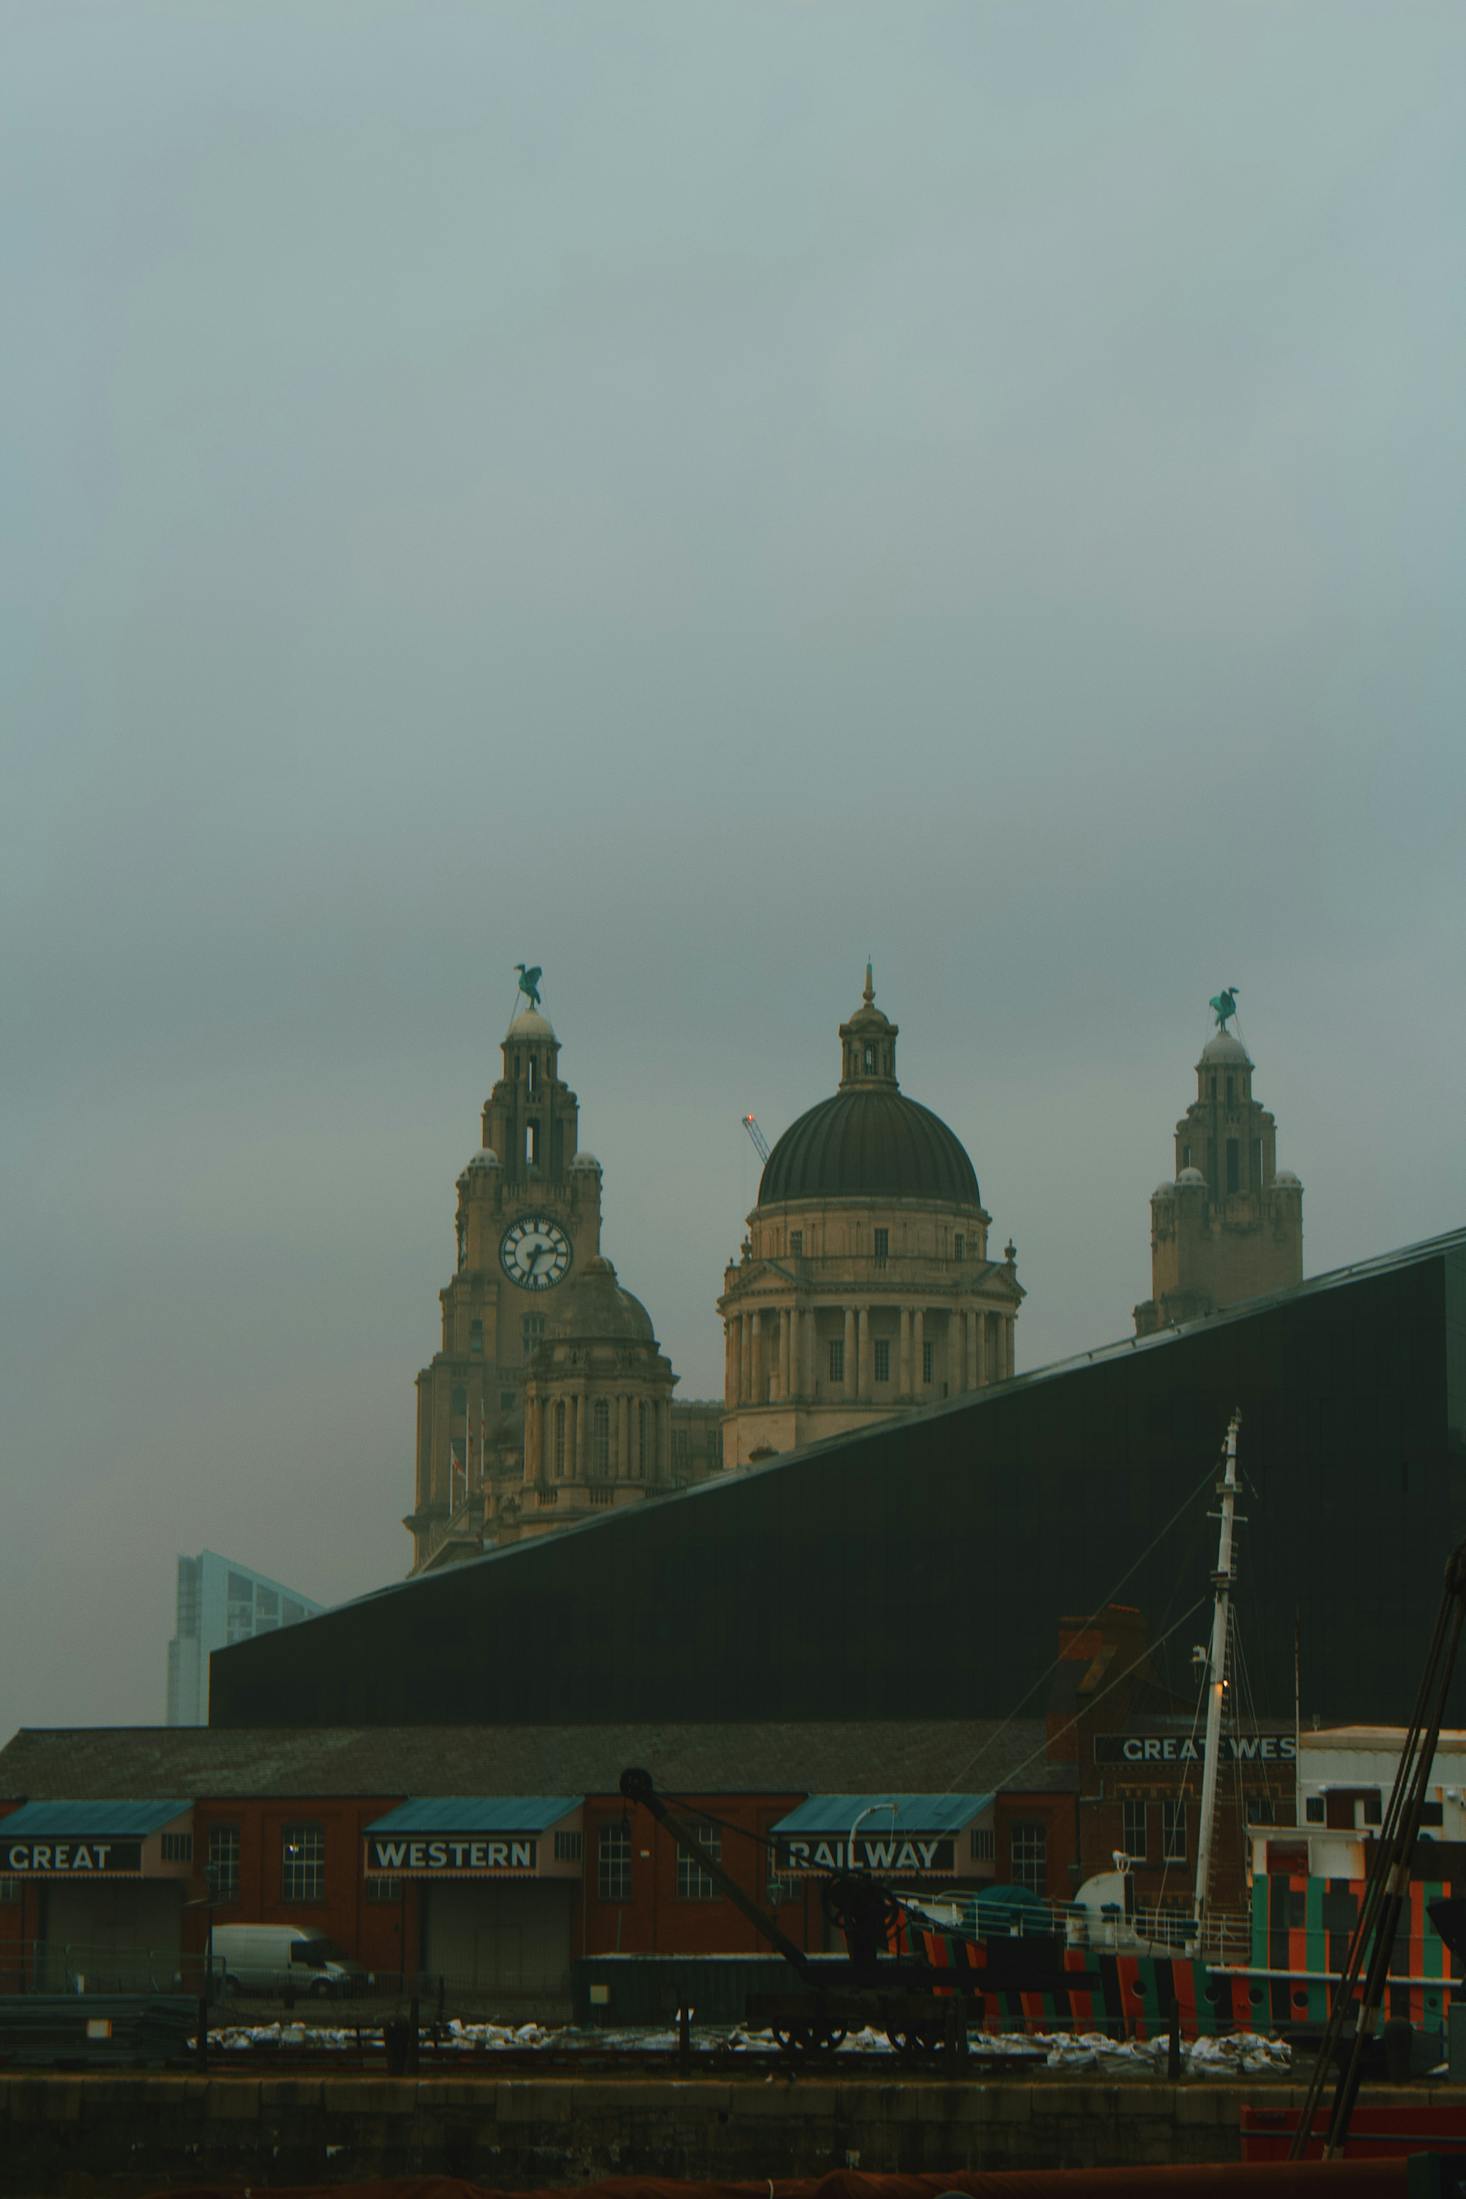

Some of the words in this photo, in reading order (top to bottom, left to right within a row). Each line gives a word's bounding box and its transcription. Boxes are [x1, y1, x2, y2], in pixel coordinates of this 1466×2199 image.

[8, 1844, 112, 1870] GREAT
[375, 1841, 531, 1868] WESTERN
[789, 1841, 939, 1869] RAILWAY
